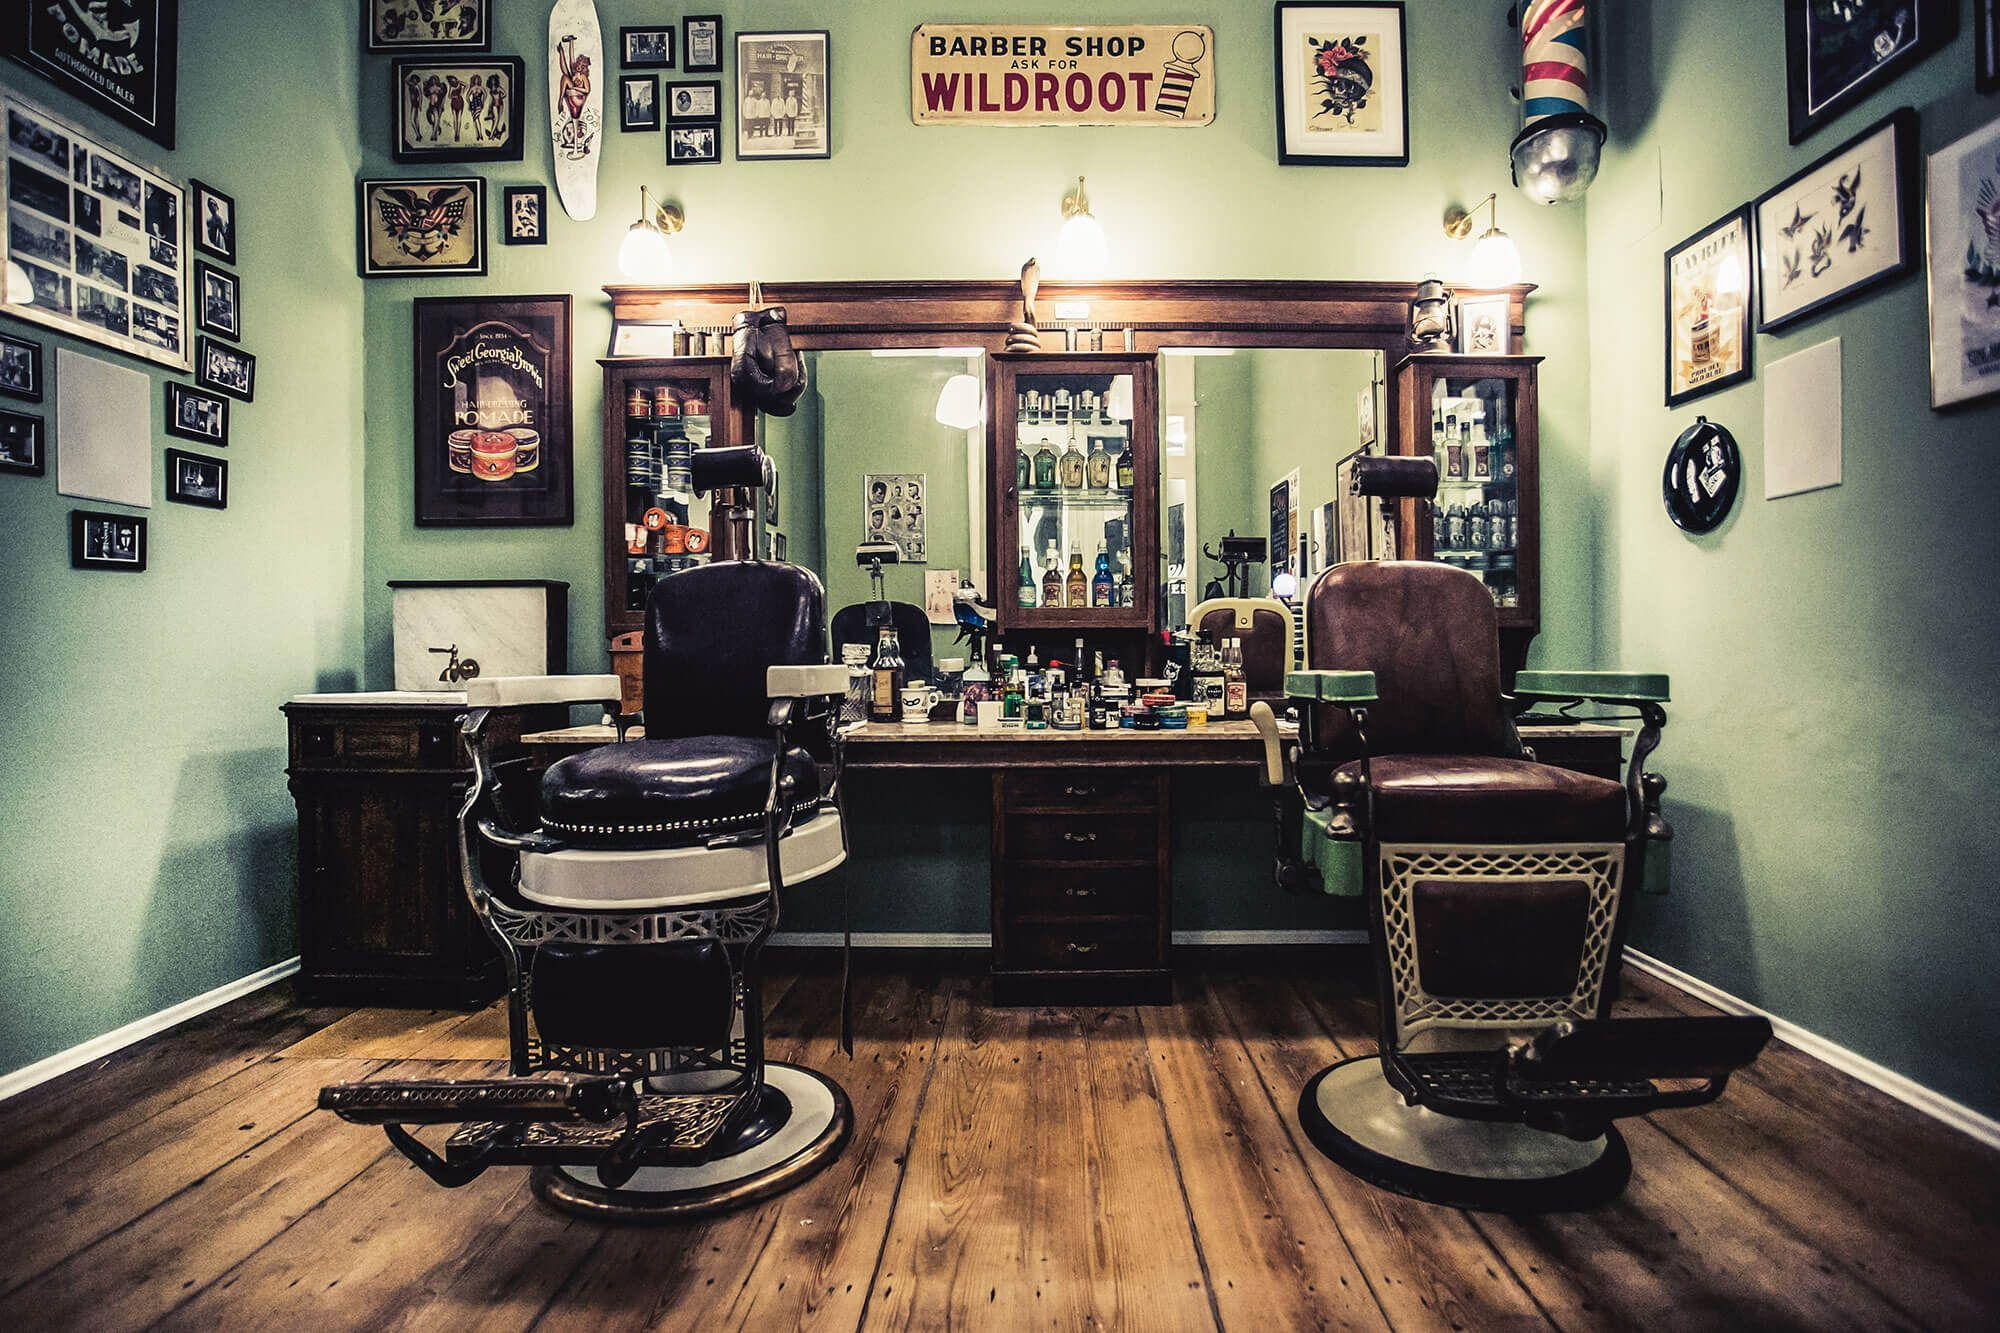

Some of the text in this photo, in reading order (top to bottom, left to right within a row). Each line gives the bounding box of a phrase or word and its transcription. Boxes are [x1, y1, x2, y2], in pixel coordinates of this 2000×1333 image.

[47, 3, 144, 75] POMADE
[929, 36, 1145, 57] BARBER SHOP
[54, 47, 135, 104] AUTHORIZED DEALER
[1010, 59, 1078, 70] ASK FOR
[921, 72, 1154, 113] WILDROOT
[443, 342, 543, 389] Sweet Georgia Brown
[454, 410, 534, 426] POMADE
